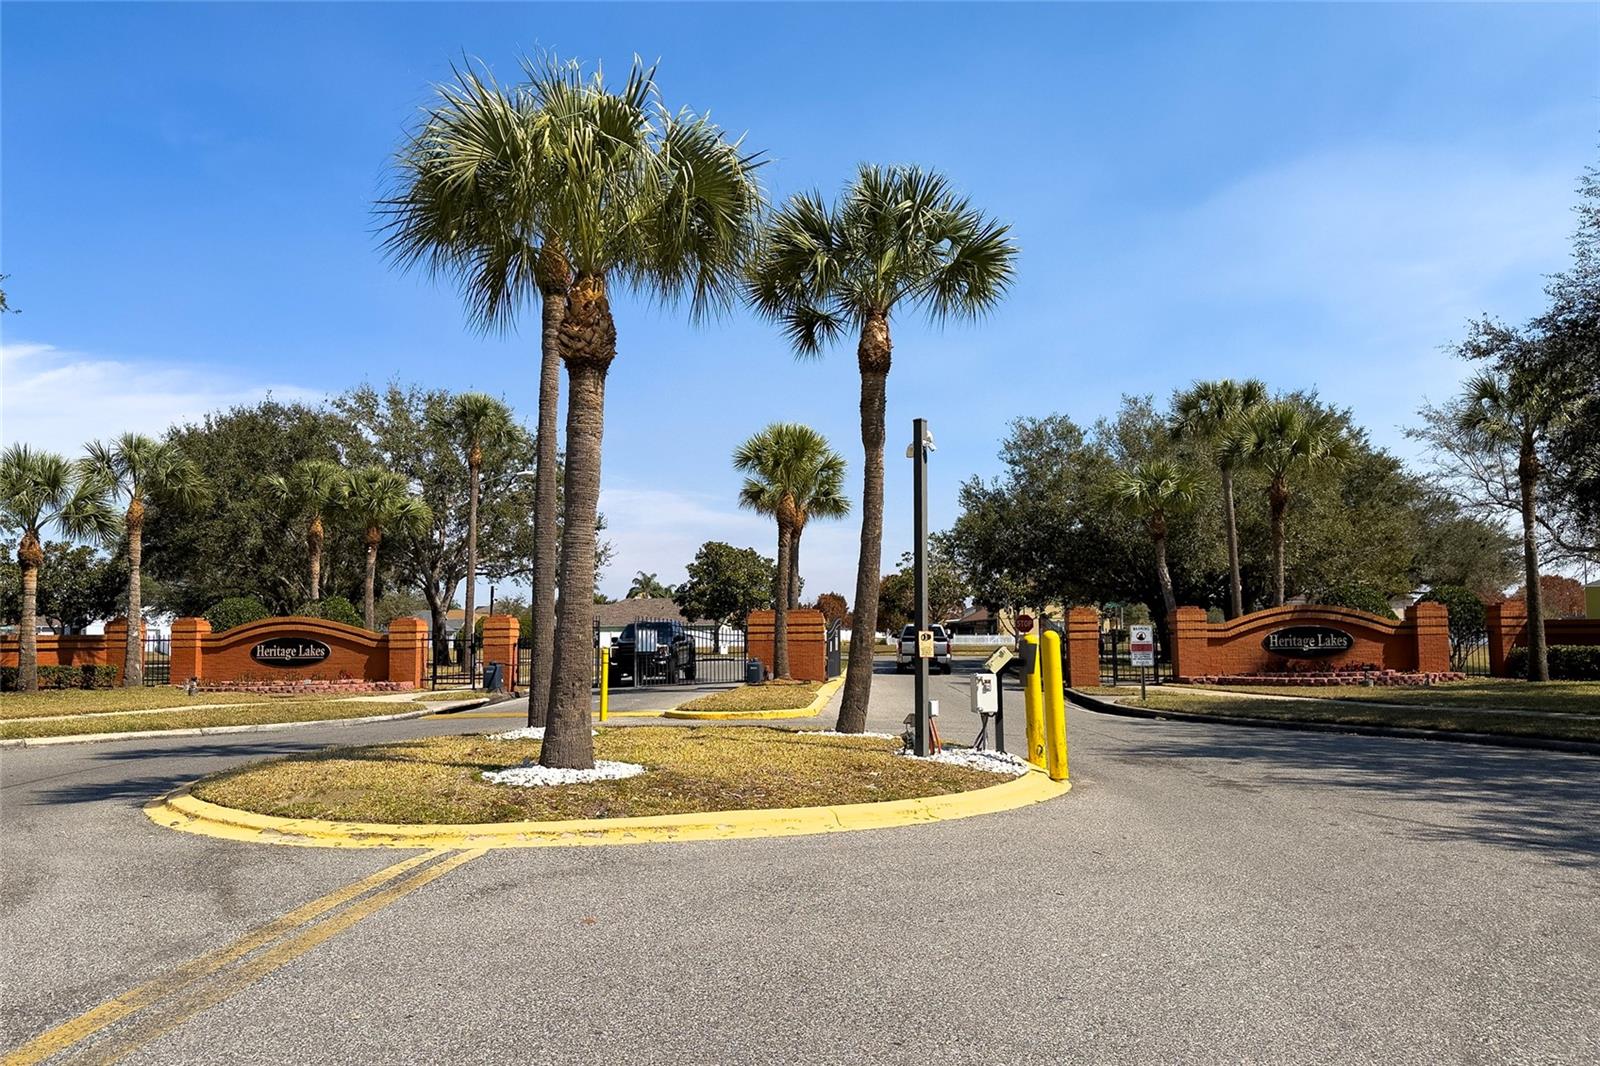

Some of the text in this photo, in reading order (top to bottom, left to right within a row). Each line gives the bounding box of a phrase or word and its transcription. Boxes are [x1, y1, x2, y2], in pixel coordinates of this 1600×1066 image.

[1016, 619, 1033, 628] STOP
[1269, 633, 1347, 651] Heritage Lakes
[256, 644, 326, 660] Heritage Lakes
